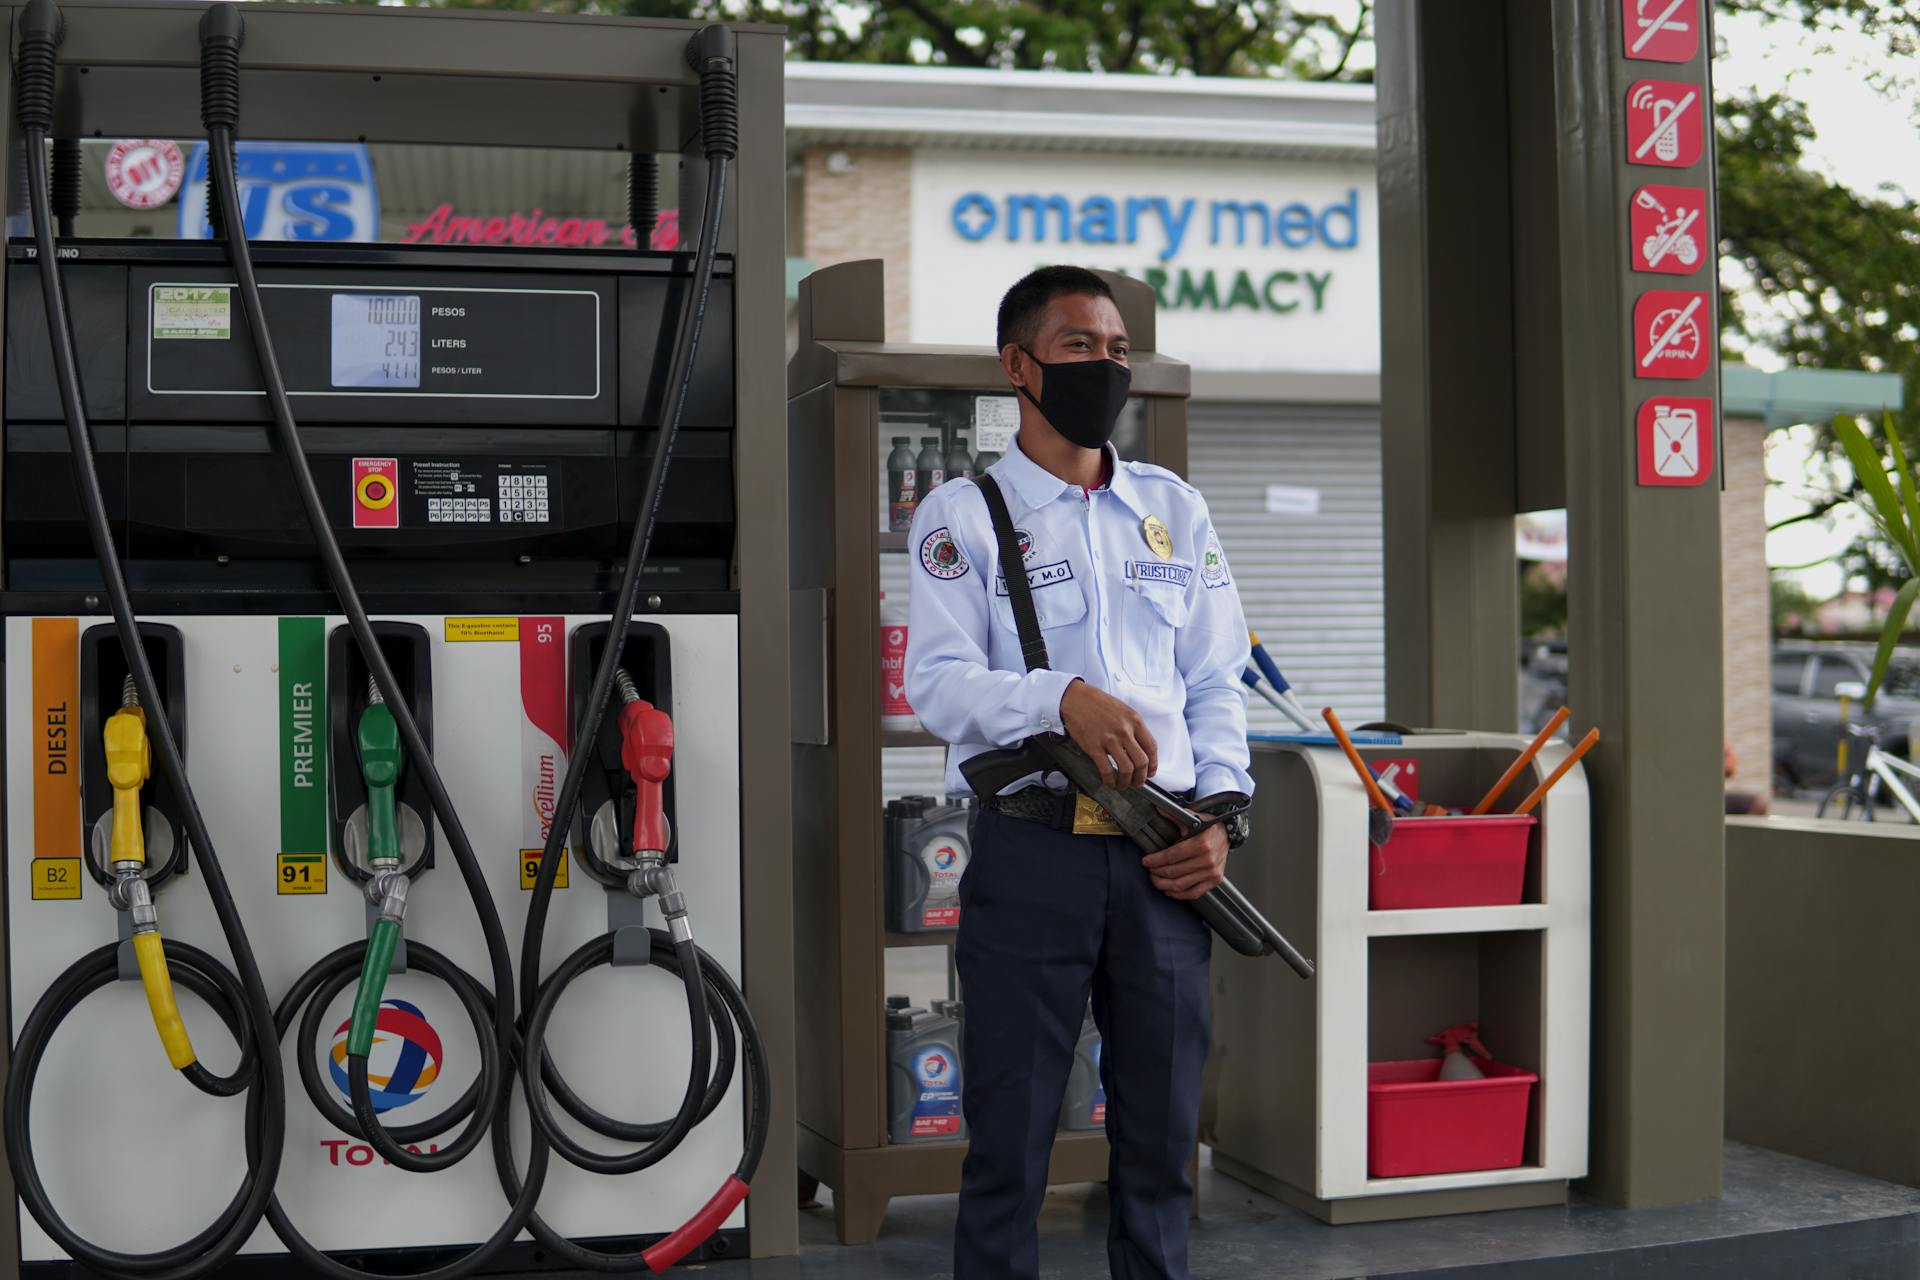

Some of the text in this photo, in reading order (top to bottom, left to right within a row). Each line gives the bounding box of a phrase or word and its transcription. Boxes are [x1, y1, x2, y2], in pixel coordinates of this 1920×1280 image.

[402, 203, 613, 246] American
[1005, 188, 1360, 263] mary med
[368, 298, 418, 325] 100.00
[431, 307, 466, 317] PESOS
[385, 330, 418, 357] 2.43
[431, 339, 466, 348] LITERS
[1664, 349, 1687, 360] RPM
[431, 367, 456, 375] PESOS
[461, 367, 482, 375] LITER
[501, 477, 508, 486] 7
[514, 476, 521, 486] 8
[526, 477, 532, 486] 9
[502, 489, 508, 498] 4
[514, 489, 520, 498] 5
[526, 489, 533, 498] 6
[515, 500, 521, 508] 2
[527, 500, 533, 508] 3
[430, 512, 490, 520] P6 P7 P8 P9 P10
[503, 511, 509, 520] 0
[514, 512, 522, 520] C
[537, 623, 552, 643] 95
[48, 702, 67, 775] DIESEL
[293, 682, 313, 788] PREMIER
[47, 868, 67, 882] B2
[283, 865, 309, 883] 91
[525, 861, 538, 878] 9
